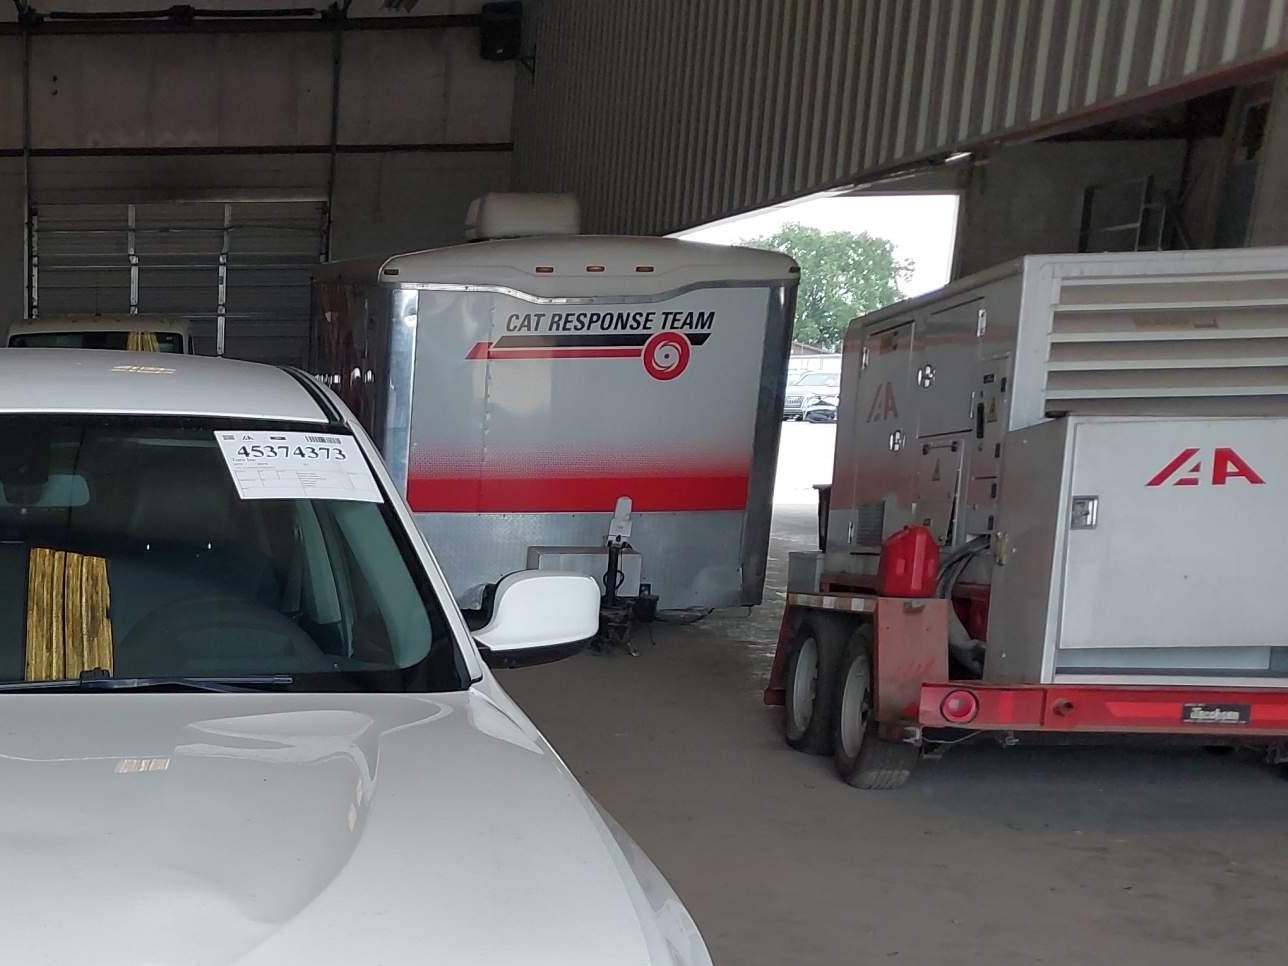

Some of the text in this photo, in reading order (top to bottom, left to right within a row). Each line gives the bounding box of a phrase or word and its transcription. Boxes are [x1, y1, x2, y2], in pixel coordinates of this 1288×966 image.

[505, 311, 716, 332] CAT RESPONSE TEAM
[237, 445, 347, 460] 45374373
